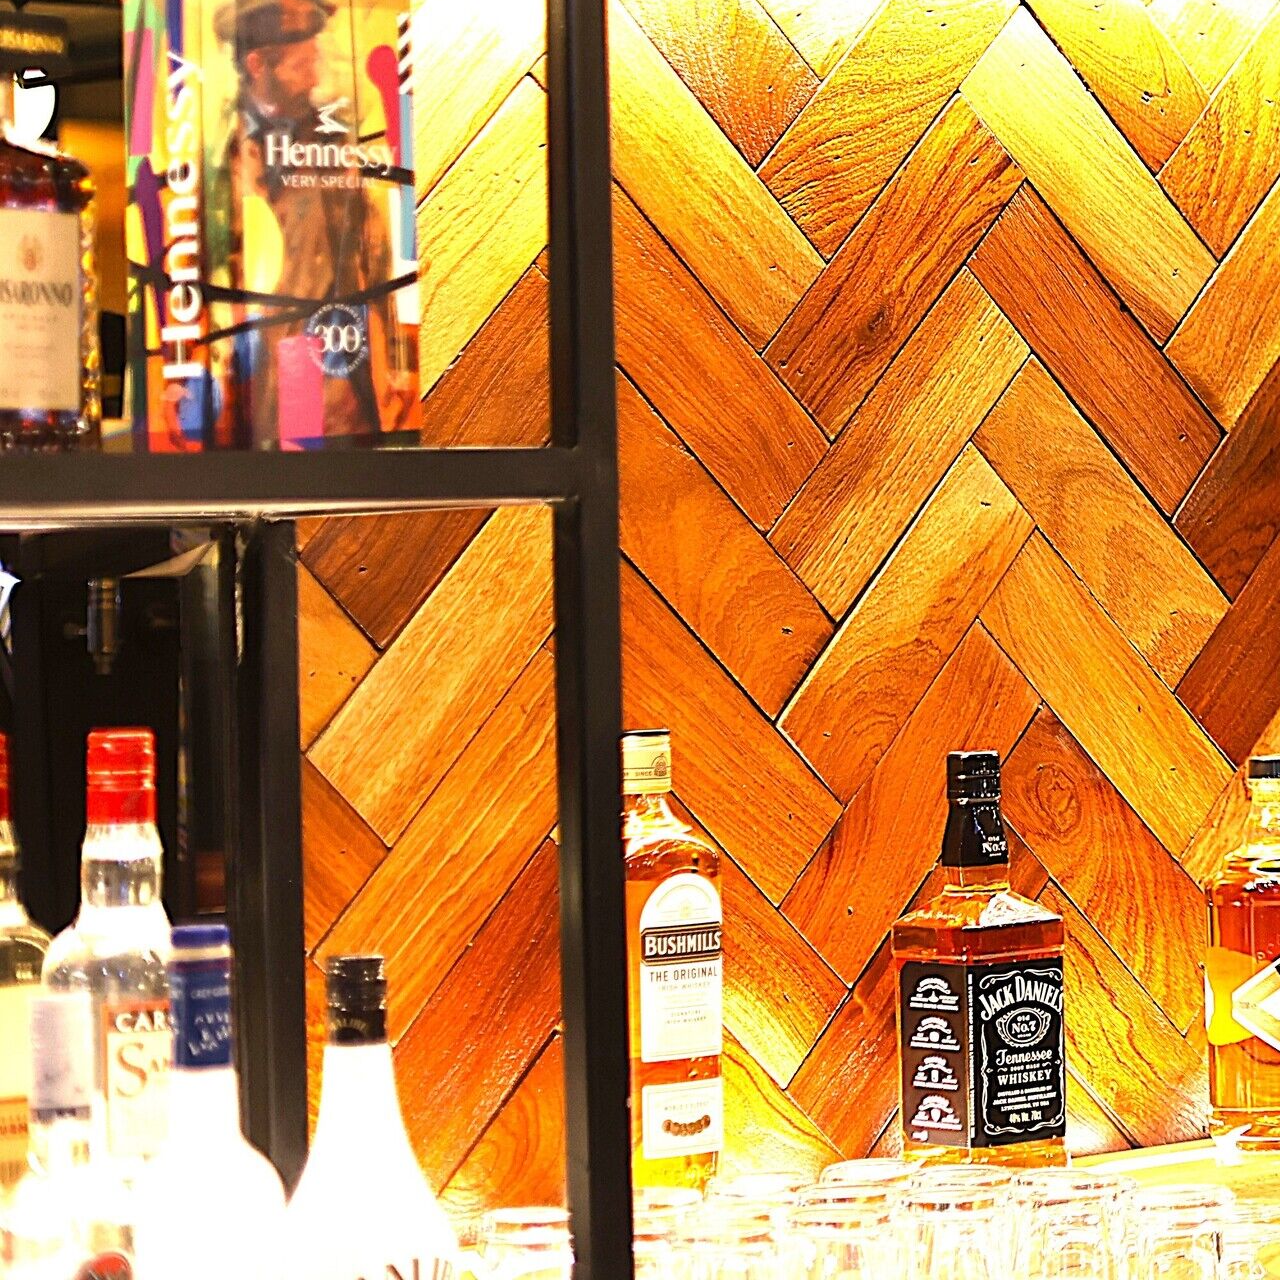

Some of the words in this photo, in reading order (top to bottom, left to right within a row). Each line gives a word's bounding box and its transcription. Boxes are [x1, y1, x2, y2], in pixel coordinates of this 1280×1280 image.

[266, 134, 397, 175] Hennessy
[281, 175, 317, 188] VERY
[162, 51, 206, 379] Hennessy
[314, 325, 360, 353] 300
[644, 930, 722, 958] BUSHMILLS
[650, 970, 668, 982] THE
[673, 966, 718, 981] ORIGINAL
[979, 983, 1015, 1020] JACK
[996, 1048, 1053, 1066] Tennessee
[997, 1069, 1052, 1086] WHISKEY
